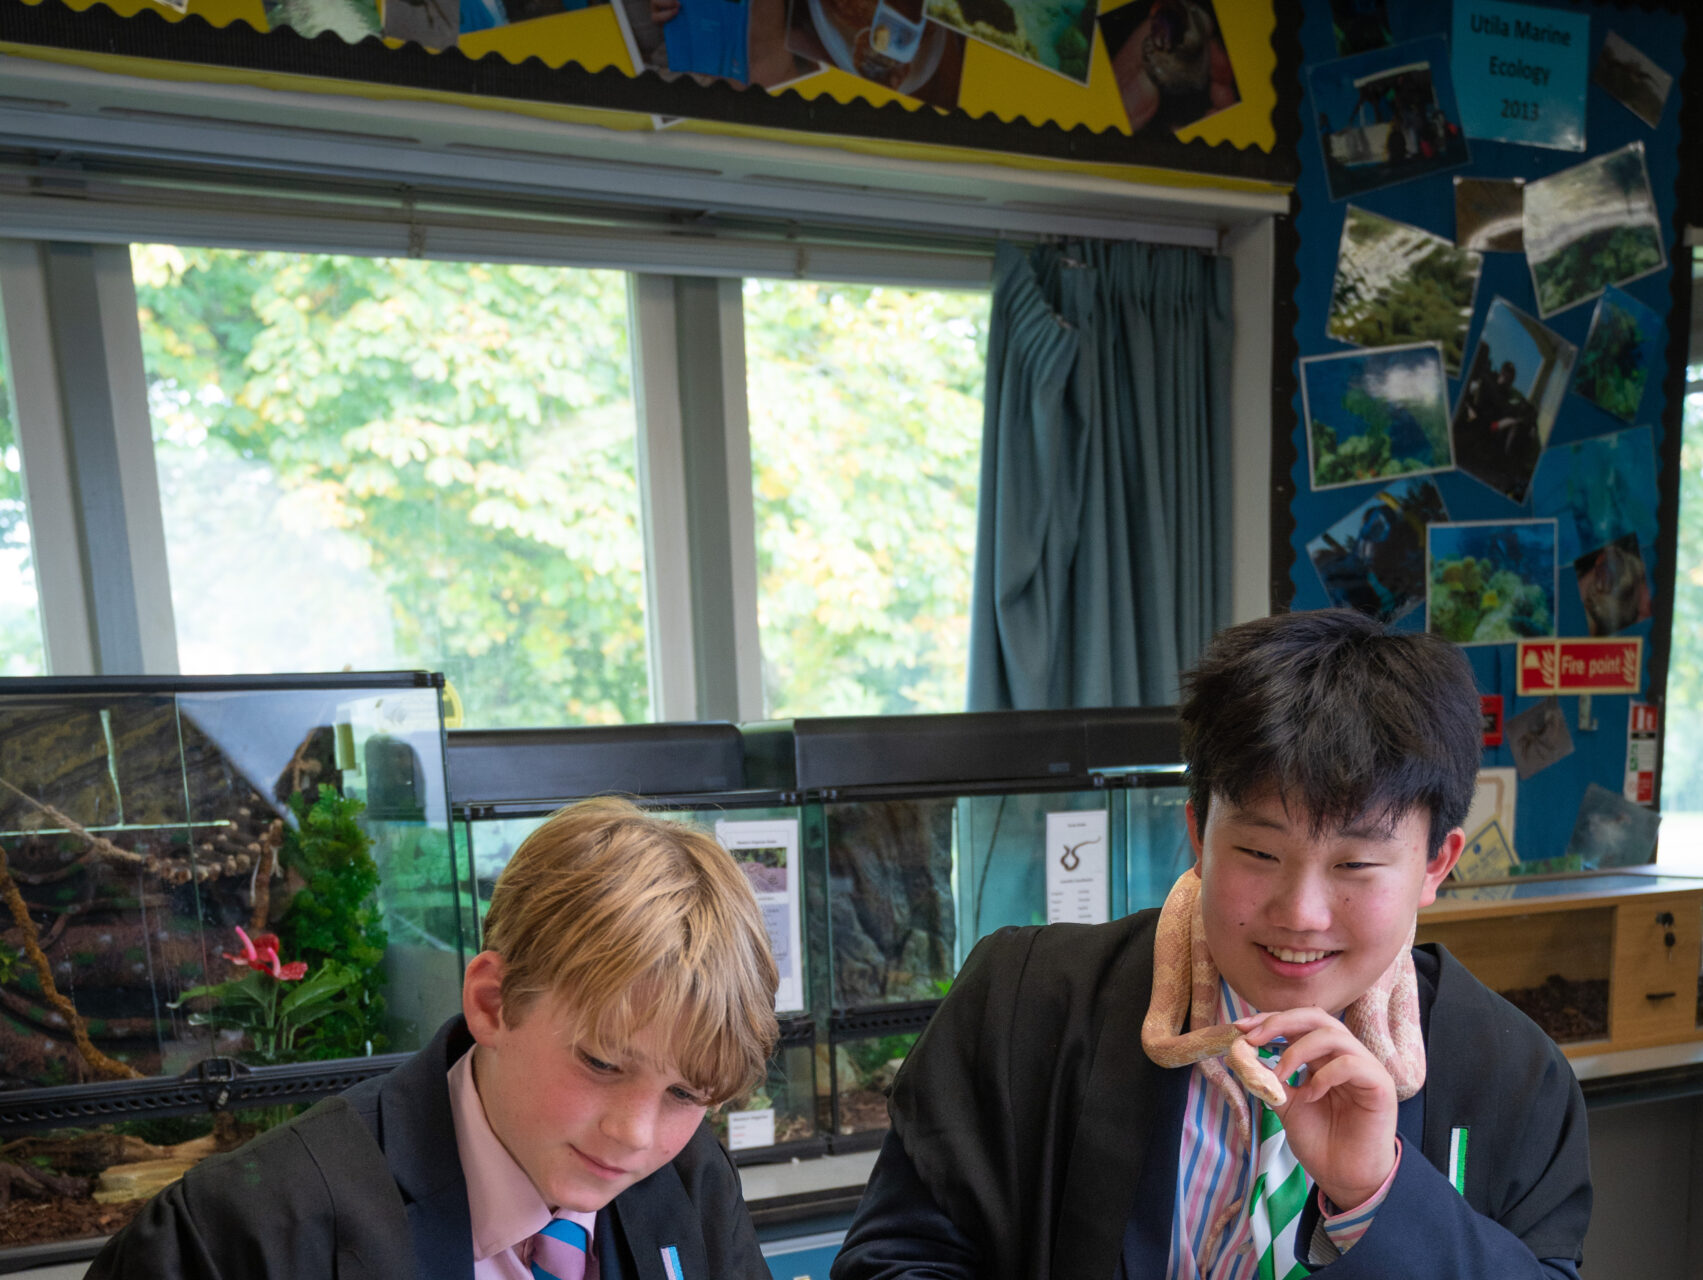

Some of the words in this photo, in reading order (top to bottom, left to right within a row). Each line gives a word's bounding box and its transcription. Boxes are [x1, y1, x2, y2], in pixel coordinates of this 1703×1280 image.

[1470, 13, 1509, 37] Utila
[1514, 18, 1572, 48] Marine
[1488, 55, 1550, 86] Ecology
[1501, 98, 1539, 122] 2013
[1561, 654, 1586, 676] Fire
[1588, 653, 1620, 679] point
